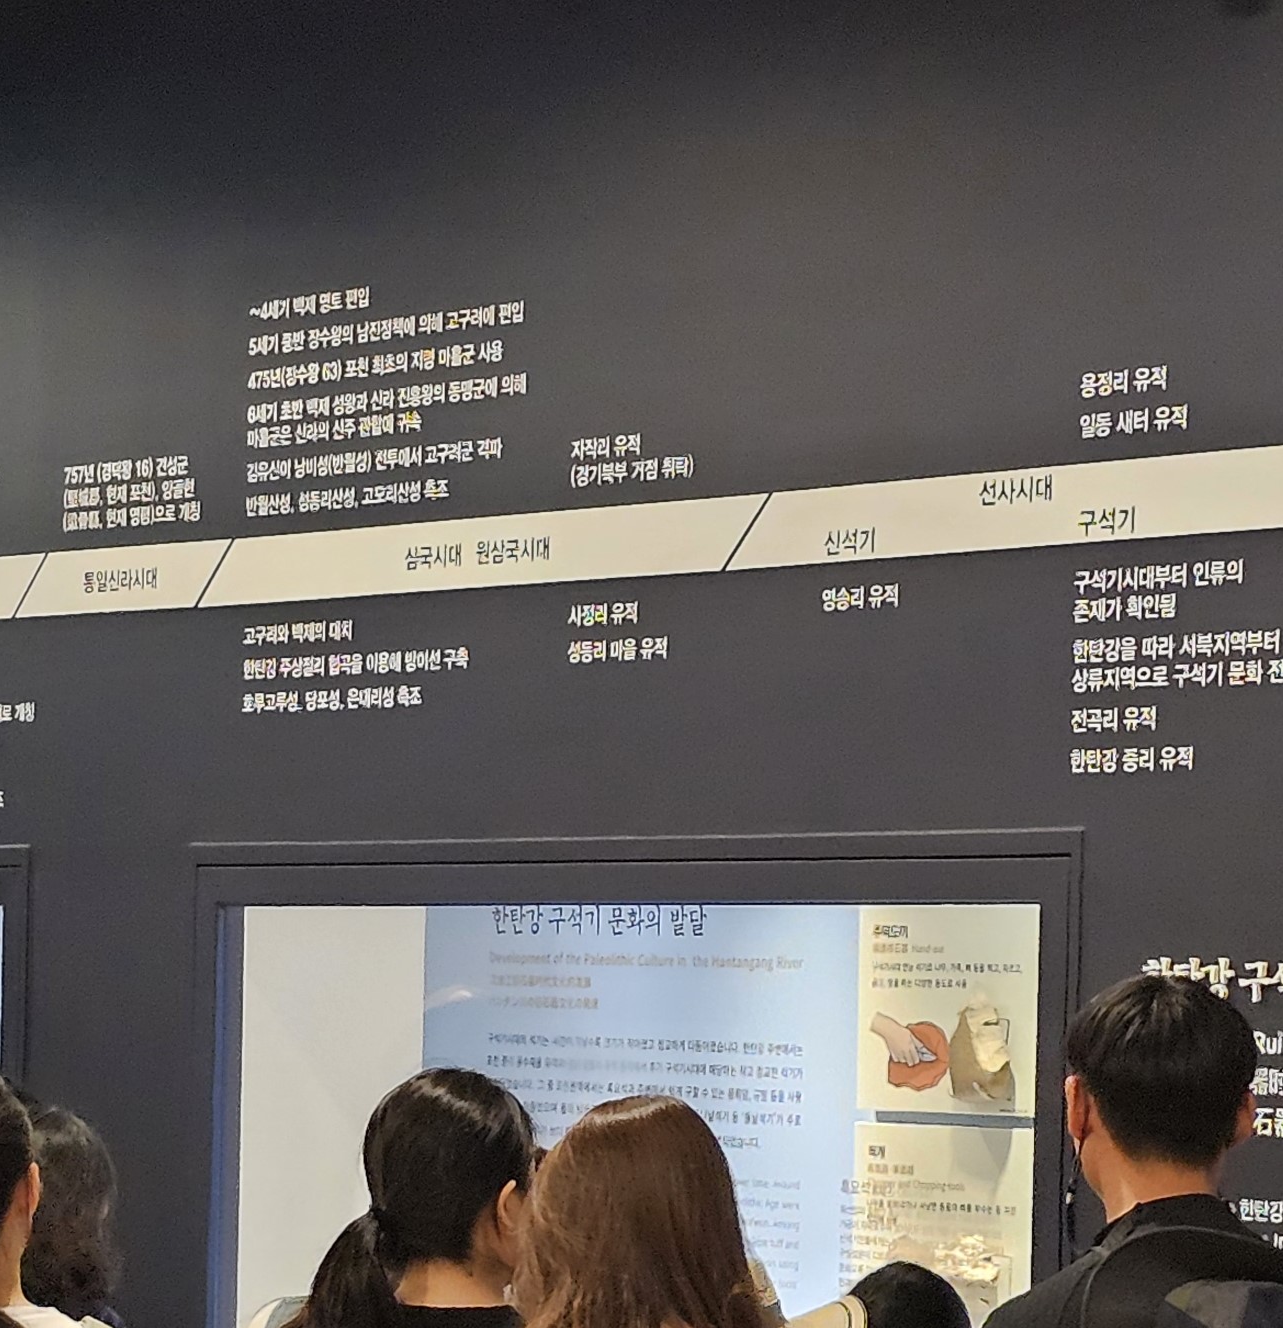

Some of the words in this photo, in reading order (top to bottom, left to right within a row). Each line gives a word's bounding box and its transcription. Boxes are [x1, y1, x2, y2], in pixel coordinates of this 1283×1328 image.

[446, 305, 495, 330] 고구려에
[499, 300, 524, 324] 편입
[344, 356, 369, 377] 포천
[478, 340, 503, 363] 사용
[1080, 369, 1128, 398] 용정리
[1133, 365, 1167, 392] 유적
[1080, 412, 1112, 438] 일동
[1116, 408, 1148, 434] 새터
[1153, 404, 1188, 431] 유적
[571, 436, 609, 461] 자작리
[614, 433, 640, 457] 유적
[64, 464, 94, 484] 757년
[135, 457, 153, 478] 16)
[631, 458, 658, 481] 거점
[979, 474, 1052, 506] 선사시대
[1078, 506, 1135, 536] 구석기
[405, 544, 461, 570] 삼국시대
[476, 537, 549, 565] 원삼국시대
[824, 527, 875, 556] 신석기
[84, 568, 157, 593] 통일신라시대
[1074, 563, 1187, 595] 구석기시대부터
[1193, 559, 1243, 586] 인류의
[868, 583, 898, 608] 유적
[1073, 597, 1122, 623] 존재가
[610, 601, 638, 625] 유적
[610, 638, 637, 661] 마을
[640, 636, 667, 660] 유적
[1073, 637, 1137, 663] 한탄강을
[1142, 634, 1174, 660] 따라
[1178, 629, 1280, 658] 서북지역부터
[1072, 666, 1168, 693] 상류지역으로
[1172, 662, 1223, 688] 구석기
[1228, 660, 1263, 685] 문화
[1071, 707, 1118, 733] 전곡리
[1123, 706, 1156, 731] 유적
[1070, 748, 1119, 773] 한탄강
[1159, 746, 1193, 771] 유적
[492, 907, 543, 934] 한탄강
[549, 907, 600, 935] 구석기
[608, 907, 660, 936] 문화의
[671, 907, 707, 936] 발달
